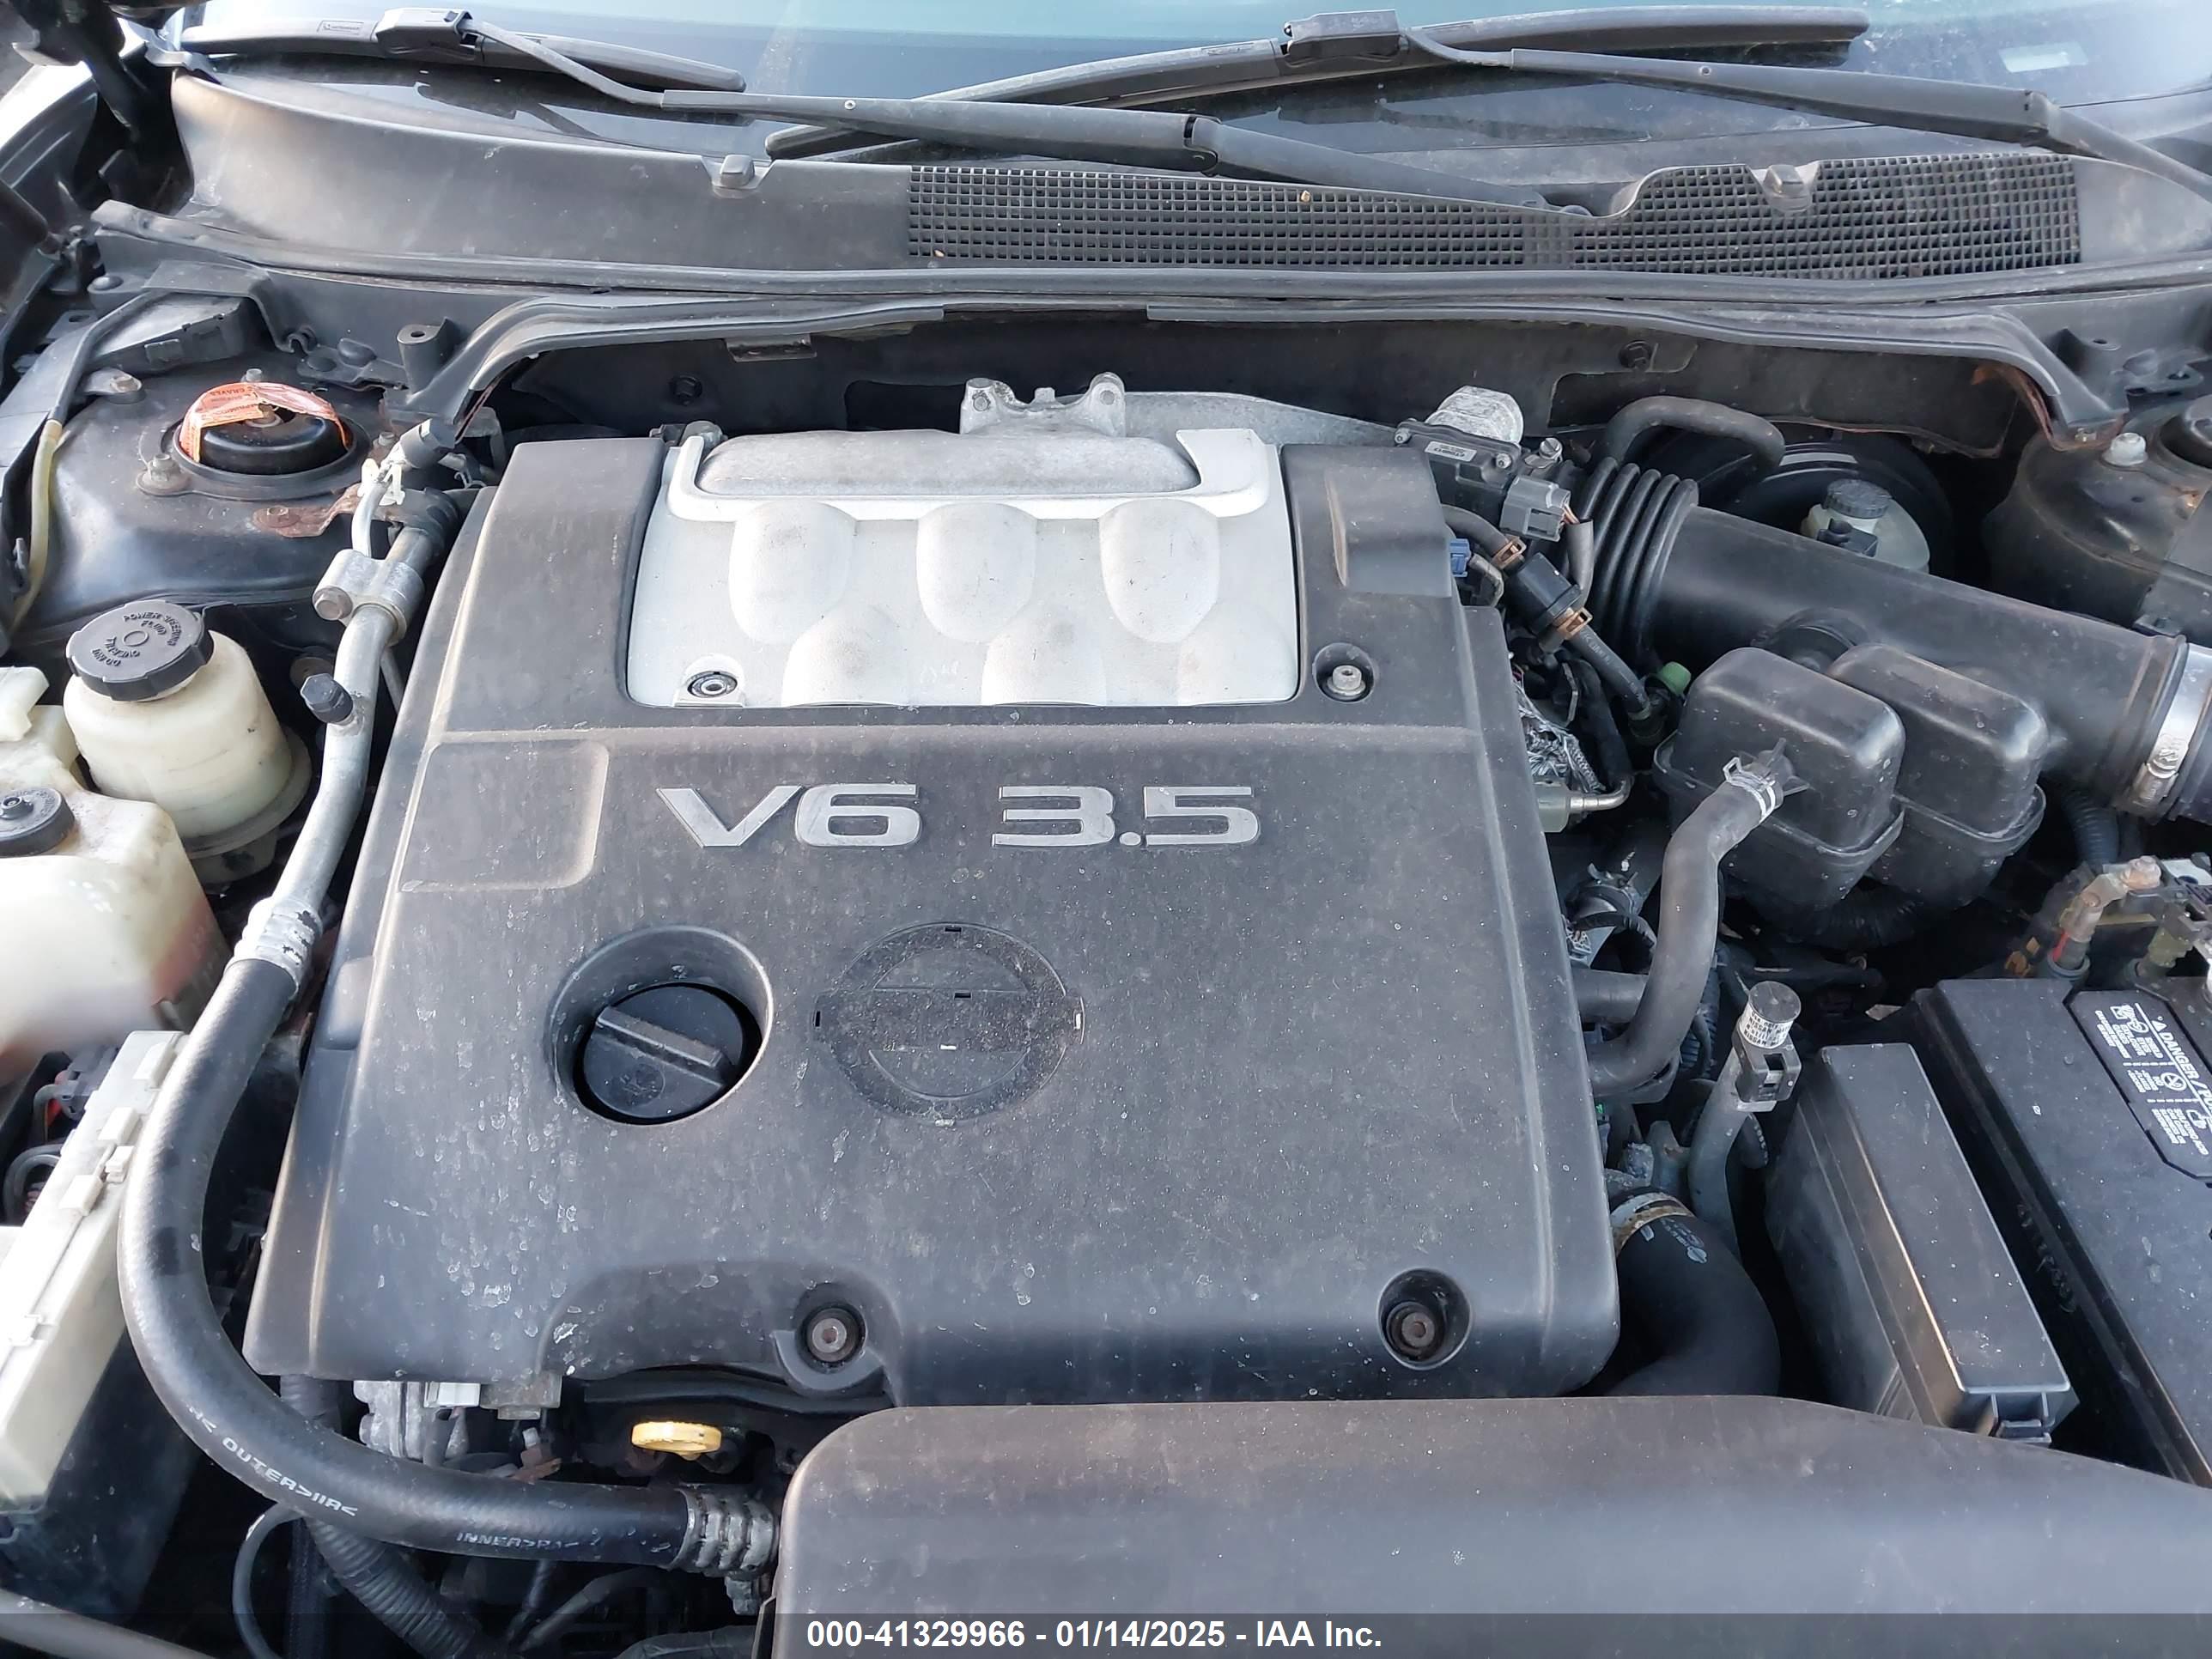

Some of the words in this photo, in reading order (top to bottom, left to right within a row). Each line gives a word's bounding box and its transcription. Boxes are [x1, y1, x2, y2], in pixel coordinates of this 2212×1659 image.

[123, 611, 163, 623] POWER
[656, 782, 922, 848] V6
[991, 785, 1261, 848] 3.5
